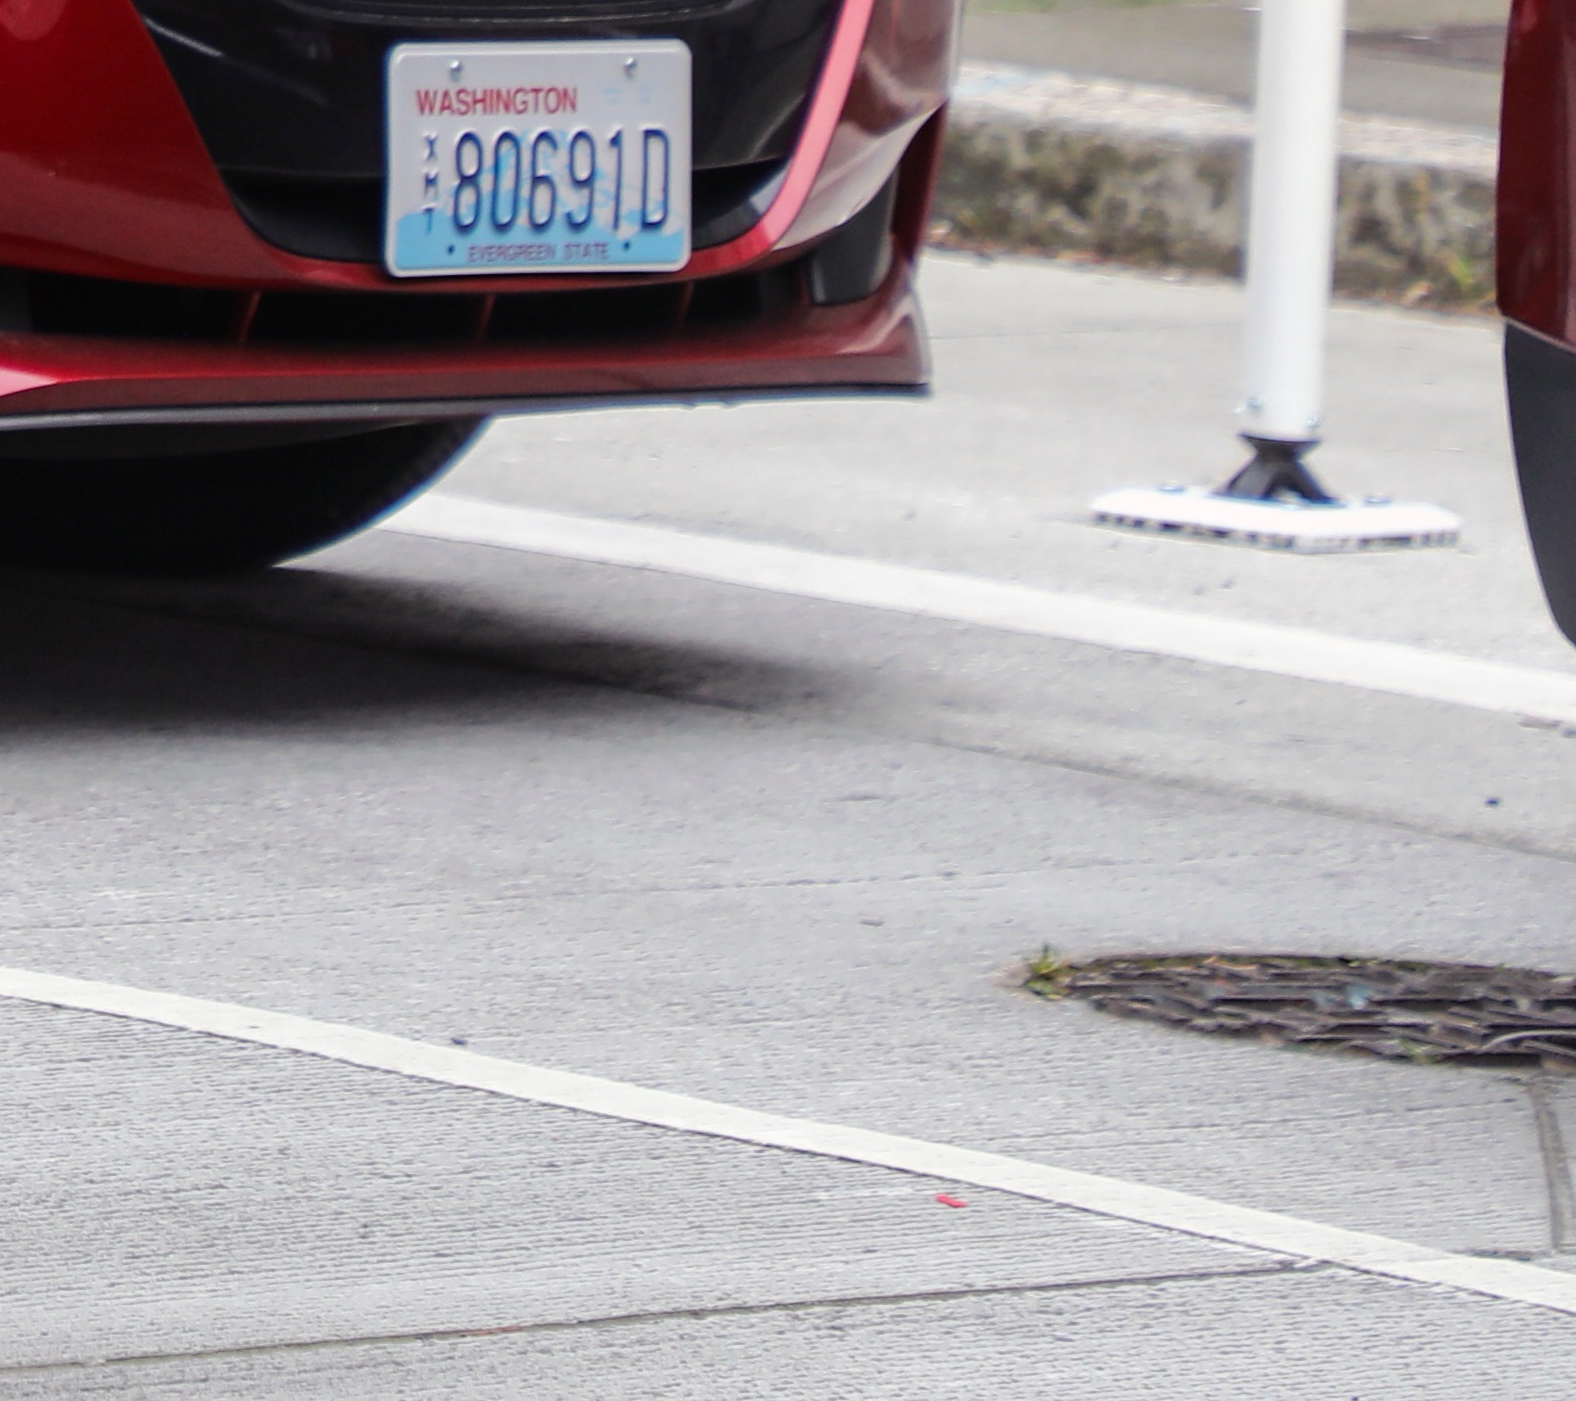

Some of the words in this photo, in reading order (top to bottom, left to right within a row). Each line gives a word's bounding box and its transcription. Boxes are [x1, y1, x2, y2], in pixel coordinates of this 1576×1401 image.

[416, 86, 577, 115] WASHINGTON
[452, 127, 670, 233] 80691D
[467, 243, 556, 263] EVERGREEN
[564, 241, 609, 260] STATE
